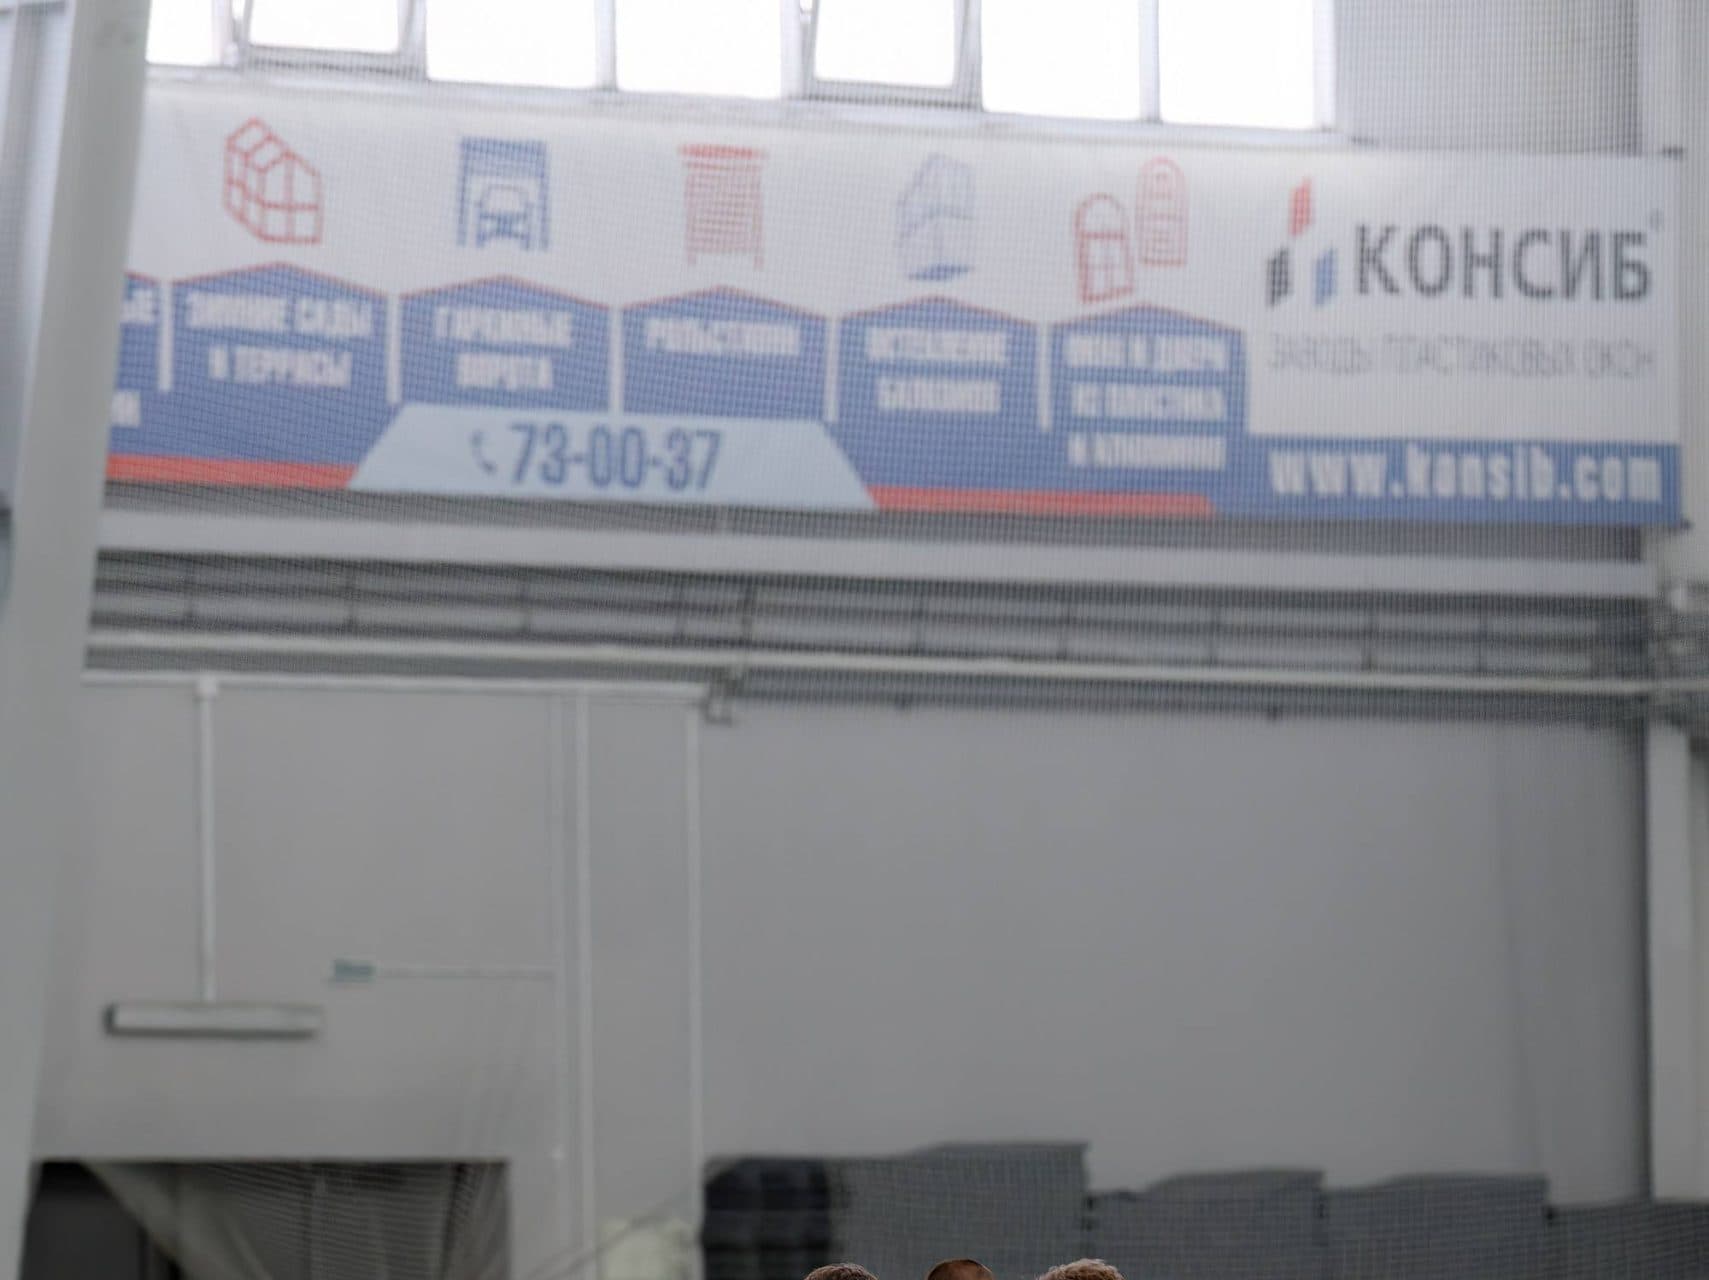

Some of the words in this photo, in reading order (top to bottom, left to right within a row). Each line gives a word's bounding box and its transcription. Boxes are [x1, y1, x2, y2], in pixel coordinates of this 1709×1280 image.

[1355, 222, 1652, 303] КОНСИБ
[510, 423, 722, 492] 73-00-37
[1270, 441, 1661, 503] www.konsib.com
